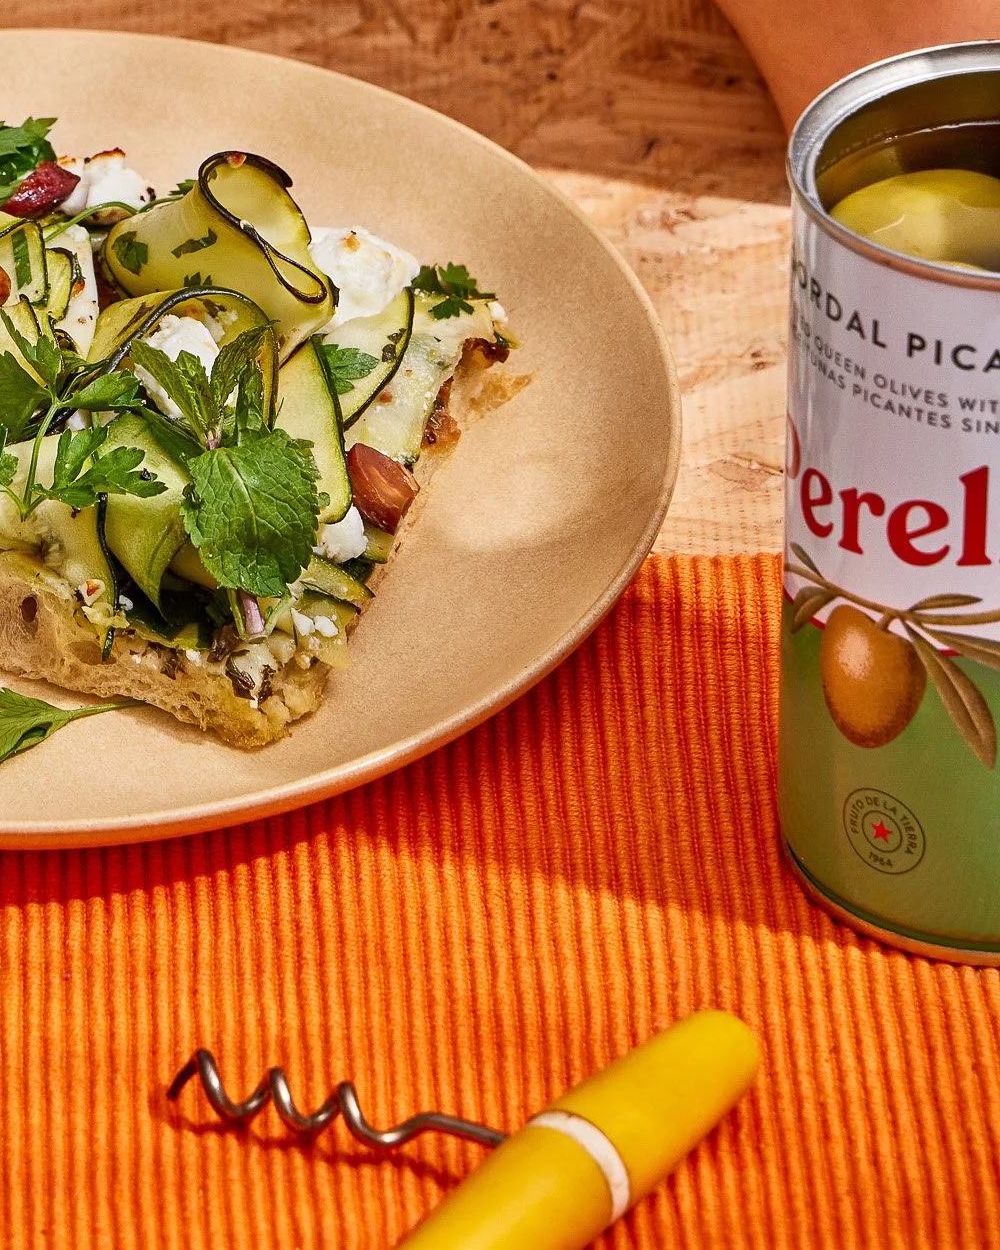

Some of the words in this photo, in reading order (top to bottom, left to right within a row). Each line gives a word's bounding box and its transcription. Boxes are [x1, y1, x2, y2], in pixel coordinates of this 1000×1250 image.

[814, 335, 866, 380] QUEEN
[873, 373, 949, 408] OLIVES
[852, 383, 951, 429] PICANTES
[961, 417, 1000, 434] SIN
[849, 799, 865, 834] FRUTO
[865, 796, 880, 807] DE
[883, 800, 897, 815] LA
[900, 814, 917, 855] TIERRA
